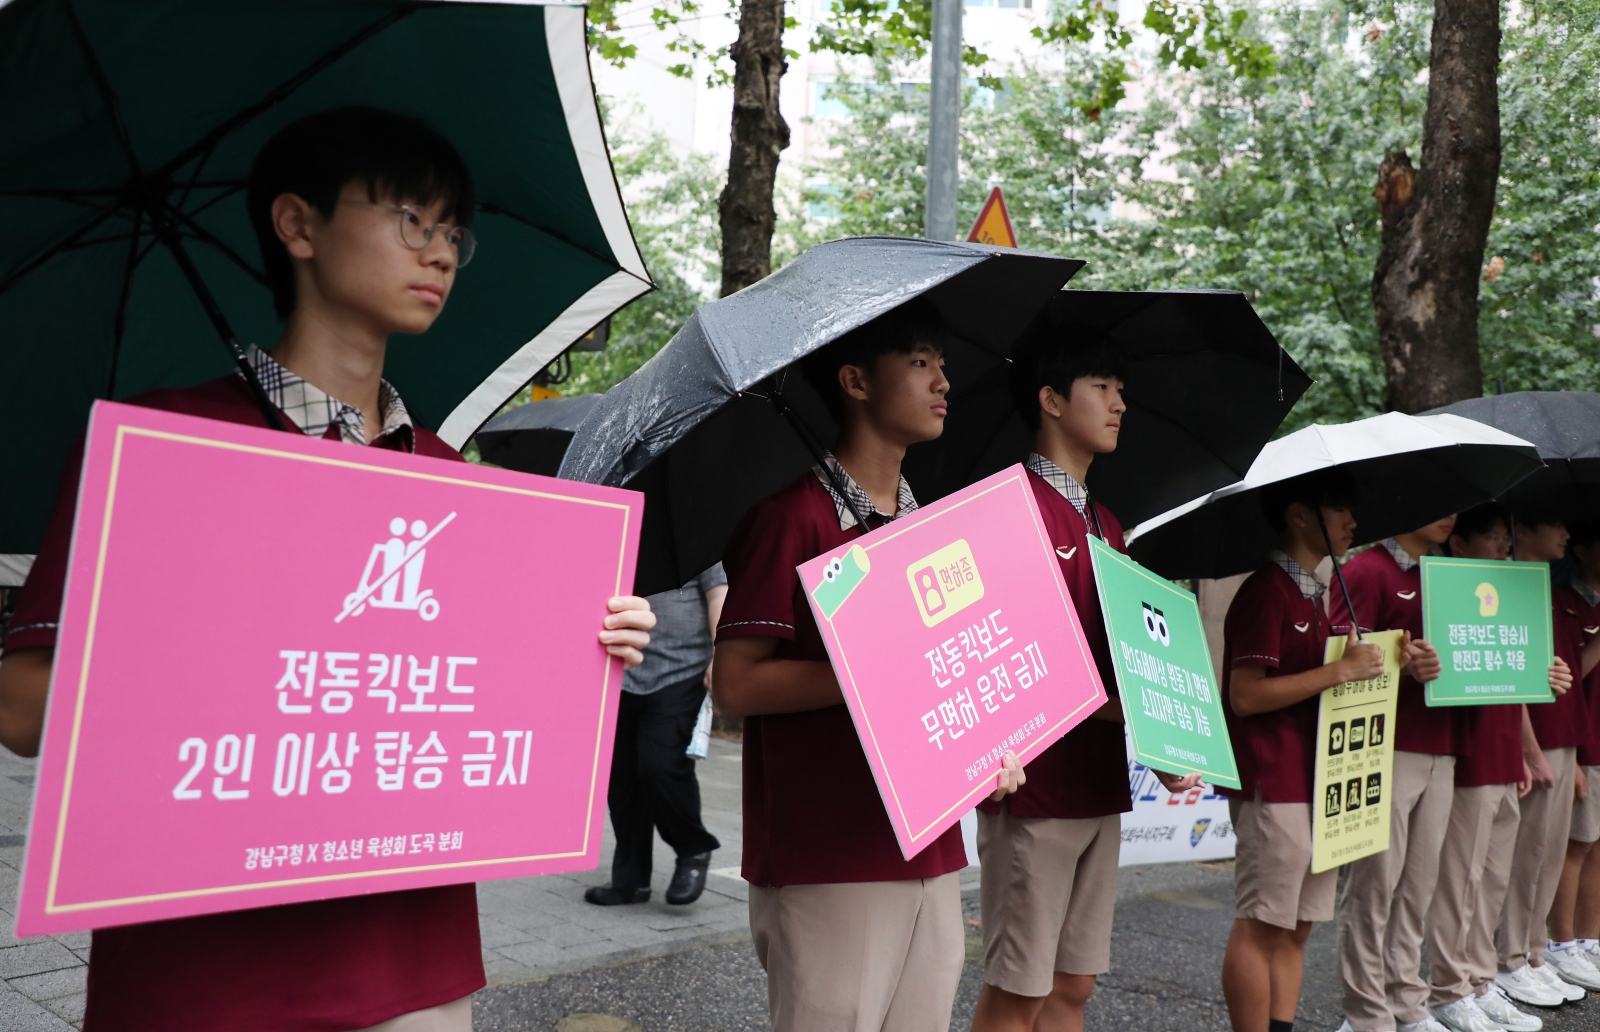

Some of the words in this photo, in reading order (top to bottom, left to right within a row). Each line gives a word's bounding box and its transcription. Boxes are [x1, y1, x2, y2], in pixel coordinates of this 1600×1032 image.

[939, 556, 974, 593] 면허증
[924, 608, 1014, 689] 전동킥보드
[1448, 624, 1497, 646] 전동킥보드
[1498, 625, 1528, 646] 탑승시
[1166, 662, 1194, 698] 원동기
[1452, 650, 1481, 671] 안전모
[1484, 650, 1503, 671] 필수
[1506, 650, 1526, 671] 착용
[275, 650, 478, 714] 전동킥보드
[921, 687, 980, 750] 무면허
[976, 663, 1016, 714] 운전
[1010, 640, 1048, 690] 금지
[1173, 699, 1194, 731] 탑승
[172, 734, 256, 801] 2인
[272, 732, 360, 797] 이상
[374, 731, 449, 791] 탑승
[461, 731, 533, 787] 금지
[965, 756, 988, 781] 강남구청
[1023, 720, 1036, 737] 도곡
[244, 843, 304, 870] 강남구청
[306, 843, 318, 863] X
[322, 839, 364, 863] 청소년
[366, 835, 407, 857] 육성회
[408, 833, 436, 854] 도곡
[438, 831, 464, 851] 분회
